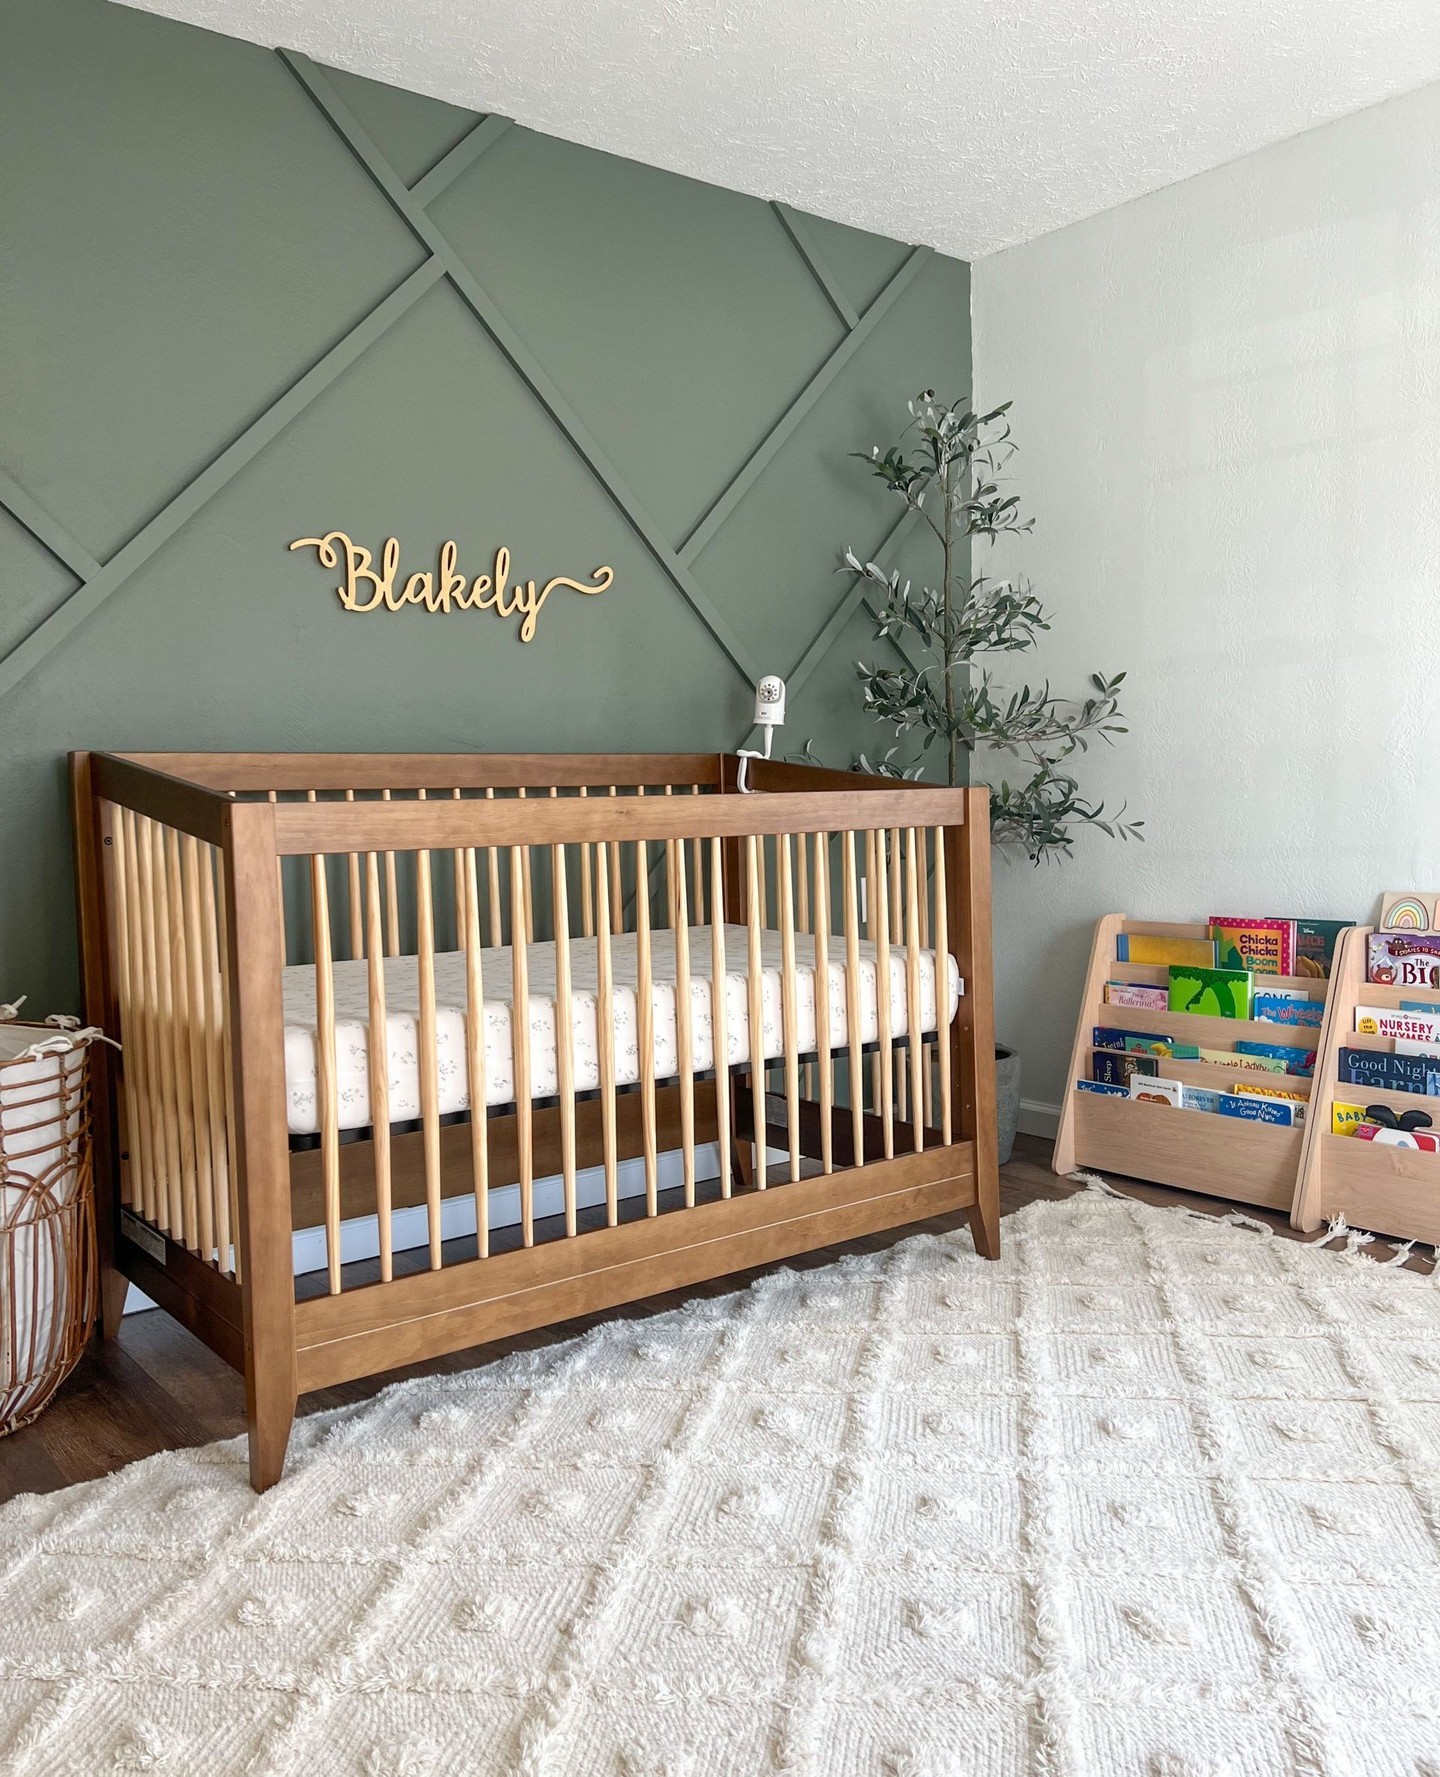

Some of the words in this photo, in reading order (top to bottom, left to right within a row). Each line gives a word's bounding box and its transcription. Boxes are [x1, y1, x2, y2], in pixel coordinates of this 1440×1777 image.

[289, 530, 615, 643] Blakely
[1239, 934, 1278, 946] Chicka
[1240, 945, 1278, 957] Chicka
[1246, 956, 1278, 967] Boom
[1414, 958, 1430, 967] The
[1277, 1003, 1323, 1021] Wheels
[1379, 1018, 1434, 1035] NURSERY
[1347, 1053, 1388, 1073] Good
[1103, 1060, 1113, 1083] Sleep
[1239, 1107, 1257, 1116] Good
[1336, 1111, 1367, 1123] BABY
